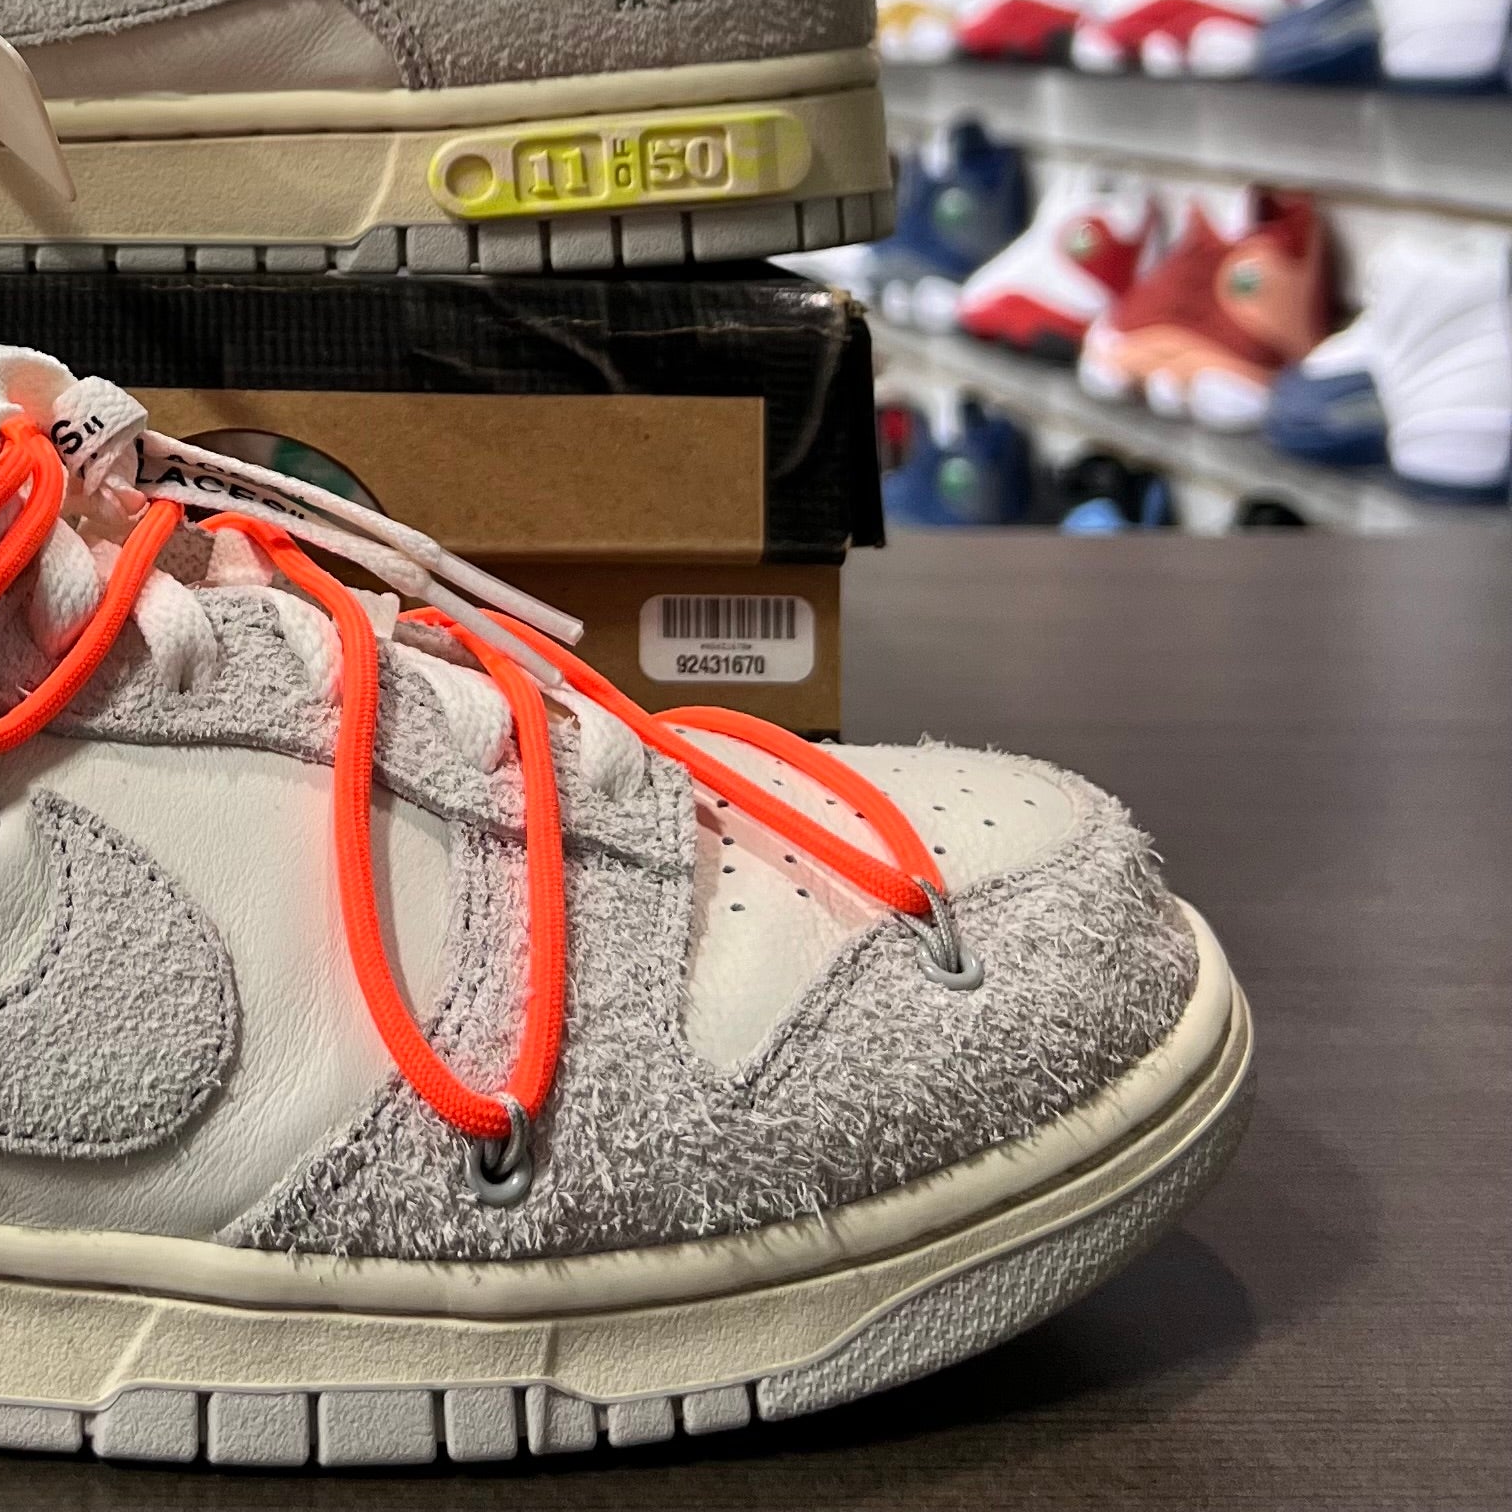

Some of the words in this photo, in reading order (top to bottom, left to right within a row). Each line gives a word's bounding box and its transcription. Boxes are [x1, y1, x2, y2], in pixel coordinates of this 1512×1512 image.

[529, 145, 589, 194] 11
[649, 136, 727, 189] 50
[676, 654, 765, 674] 92431670
